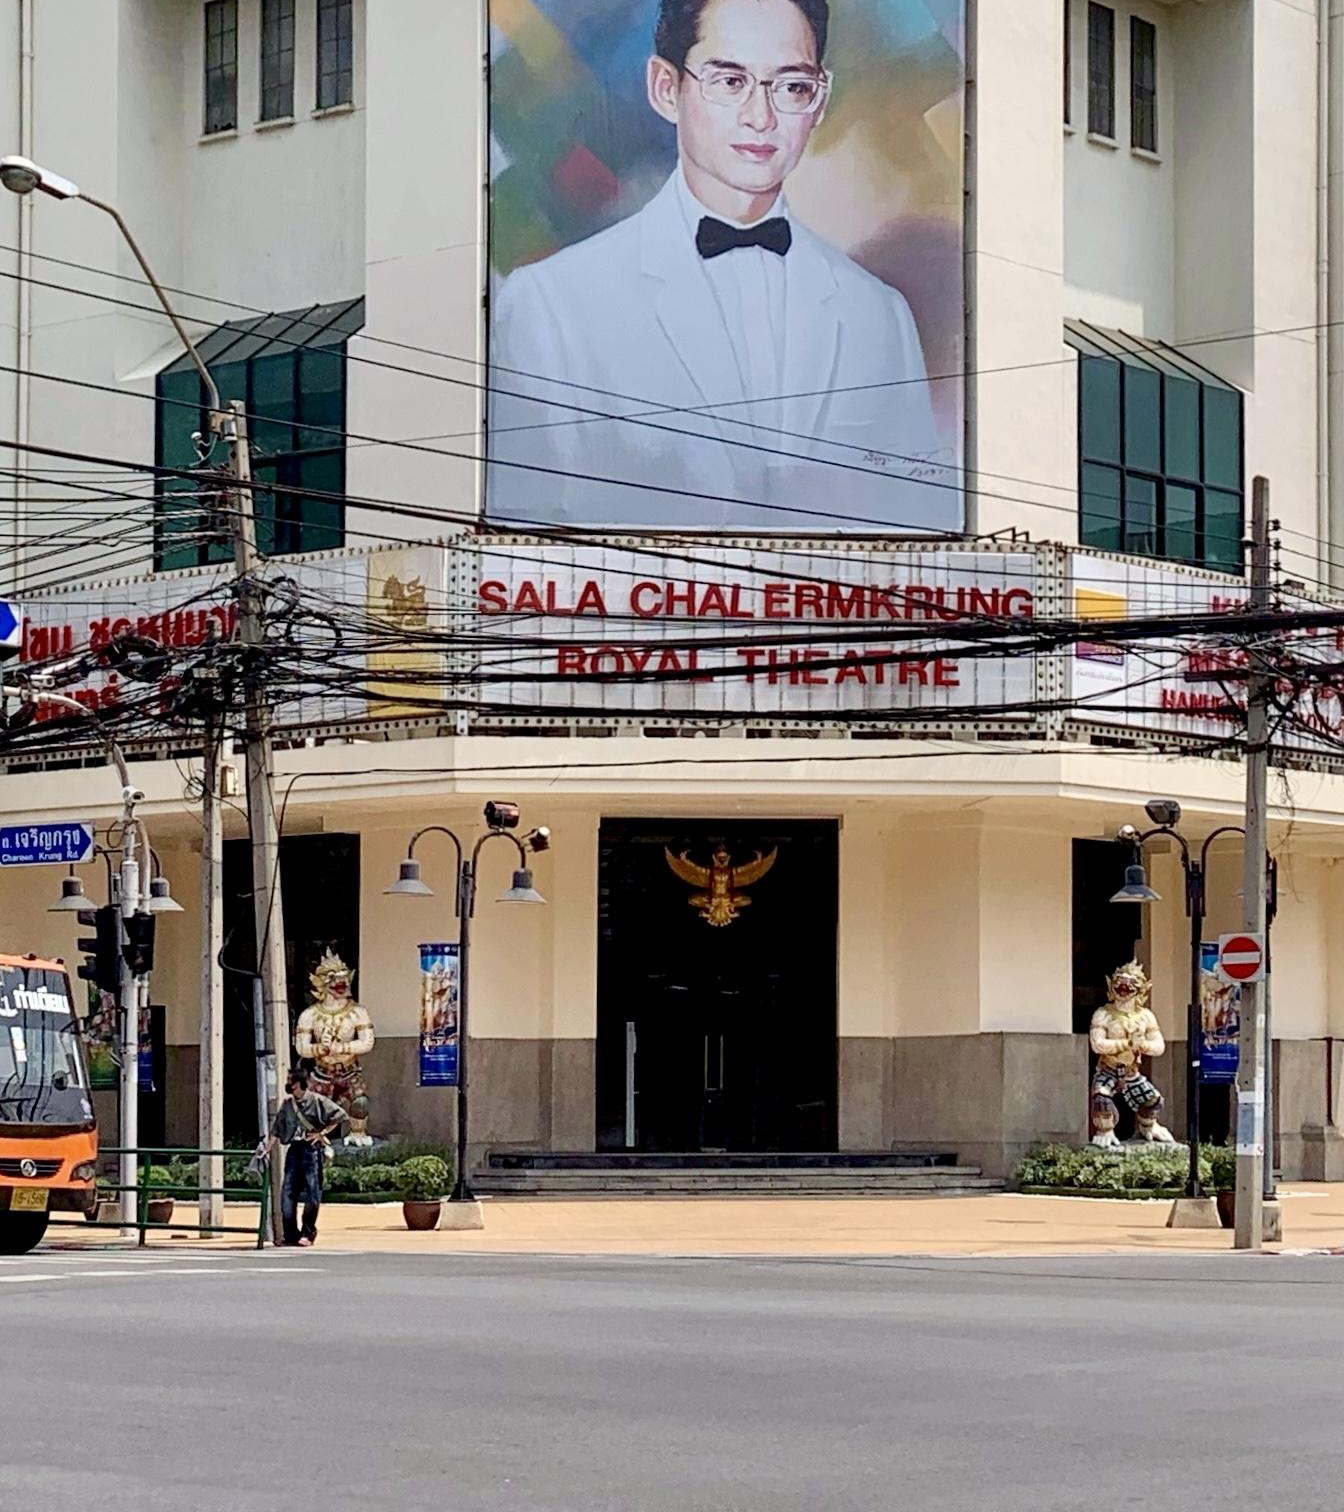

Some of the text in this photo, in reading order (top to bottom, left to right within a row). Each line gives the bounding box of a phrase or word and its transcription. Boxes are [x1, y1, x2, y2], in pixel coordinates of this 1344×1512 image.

[478, 580, 607, 616] SALA
[558, 646, 960, 687] ROYAL THEATRE
[15, 828, 80, 851] เจริญกรุง
[39, 852, 62, 861] Krung
